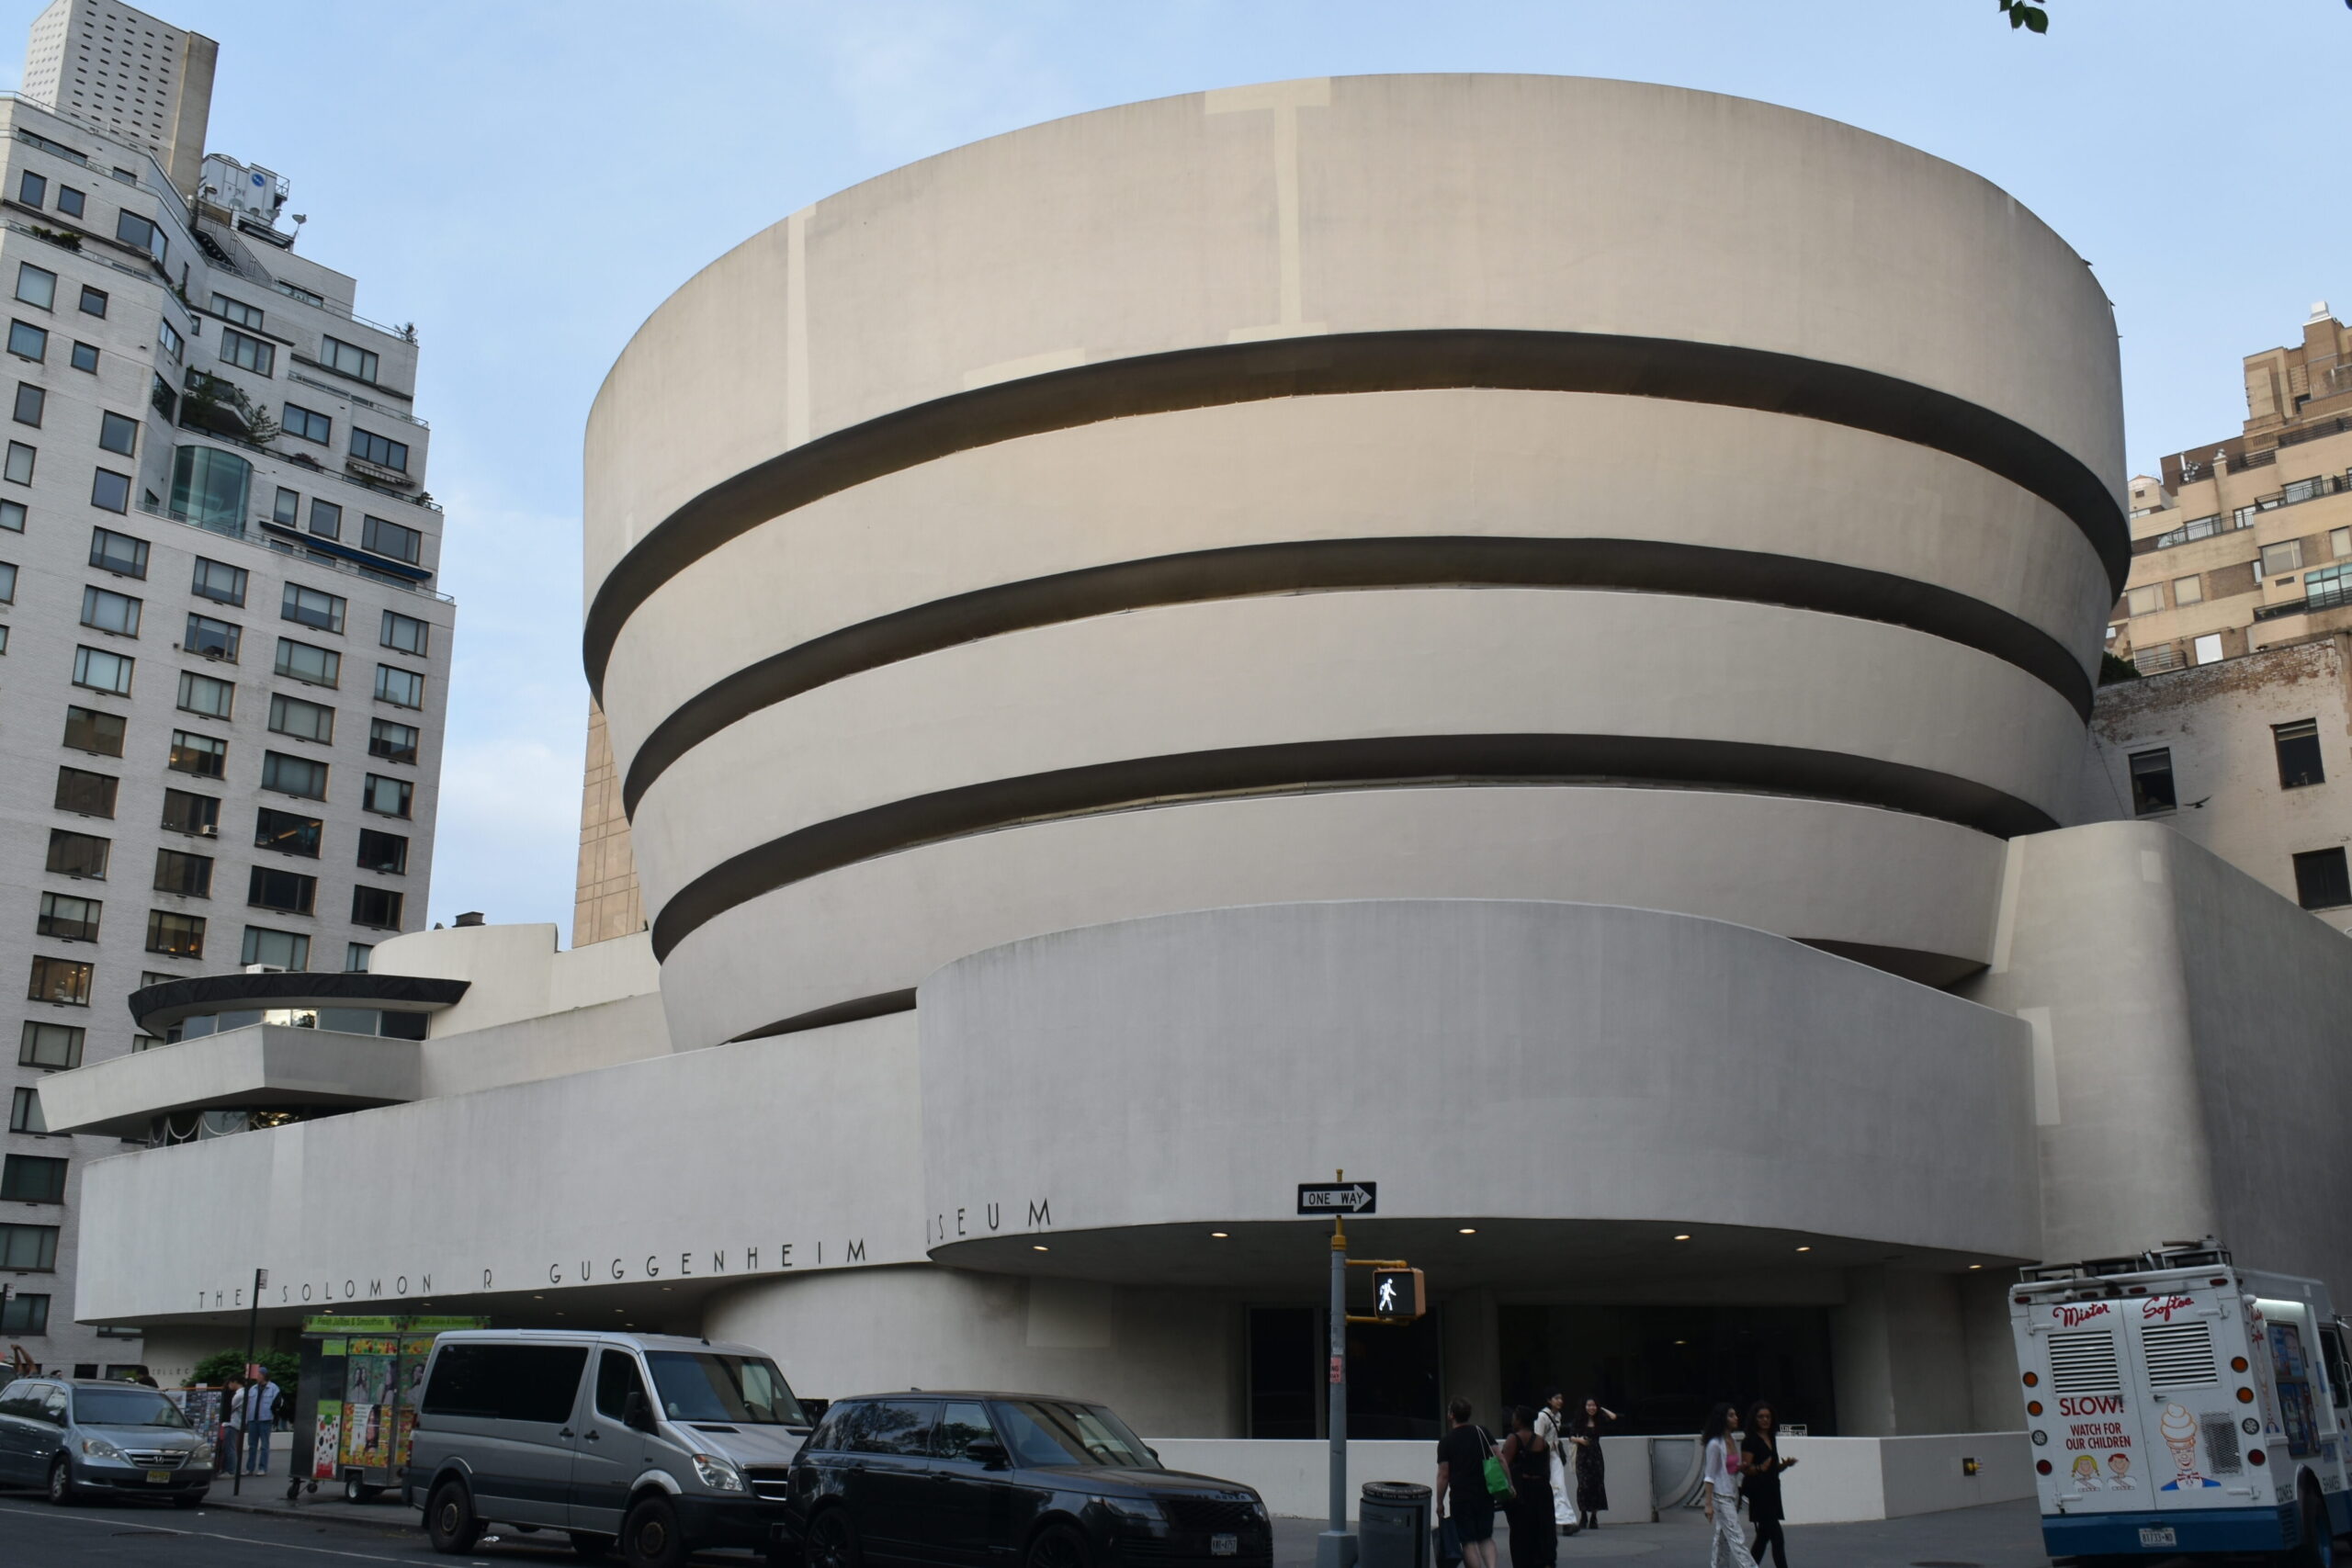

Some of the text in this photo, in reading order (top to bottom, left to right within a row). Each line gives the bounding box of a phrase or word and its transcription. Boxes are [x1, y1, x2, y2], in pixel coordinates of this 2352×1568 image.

[1308, 1192, 1364, 1205] ONE WAY
[199, 1289, 242, 1309] THE
[282, 1273, 431, 1303] SOLOMON
[484, 1269, 492, 1289] R
[550, 1238, 865, 1284] GUGGENHEIM
[2052, 1294, 2194, 1327] Mister Softee
[2060, 1395, 2124, 1416] SLOW!
[2070, 1423, 2121, 1436] WATCH FOR
[2066, 1437, 2131, 1450] OUR CHILDREN
